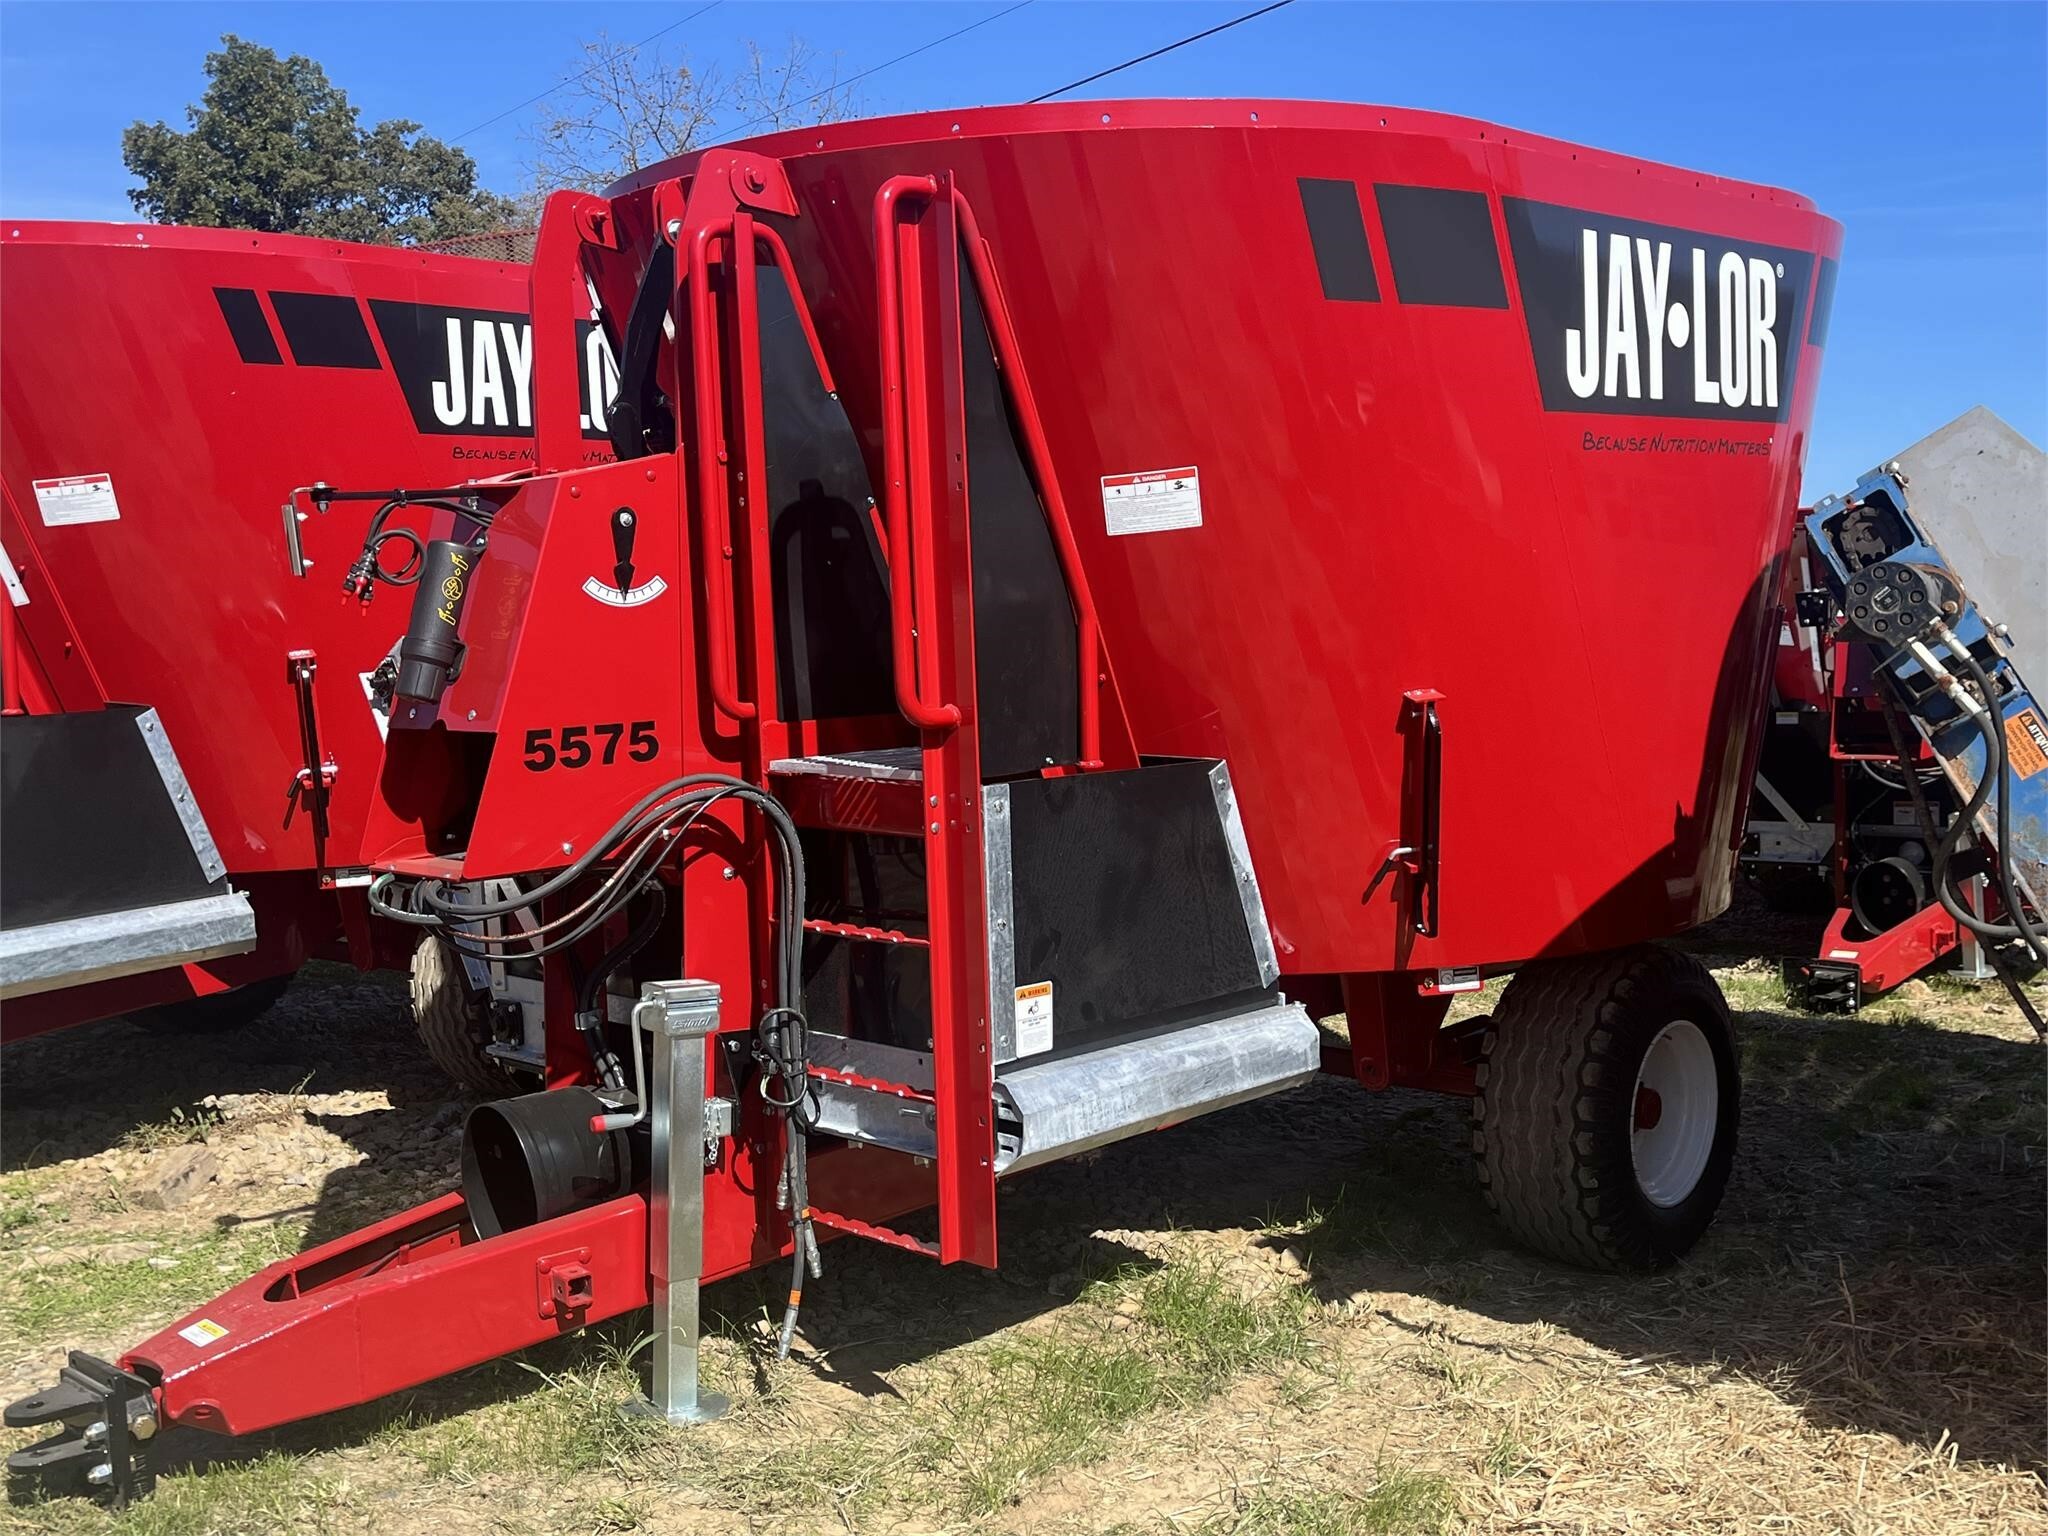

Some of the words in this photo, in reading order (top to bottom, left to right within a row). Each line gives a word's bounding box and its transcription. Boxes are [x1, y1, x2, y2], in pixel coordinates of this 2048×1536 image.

[453, 447, 516, 460] BECAUSE
[1583, 432, 1647, 452] BECAUSE
[1651, 433, 1715, 456] NUTRITION
[523, 720, 659, 772] 5575
